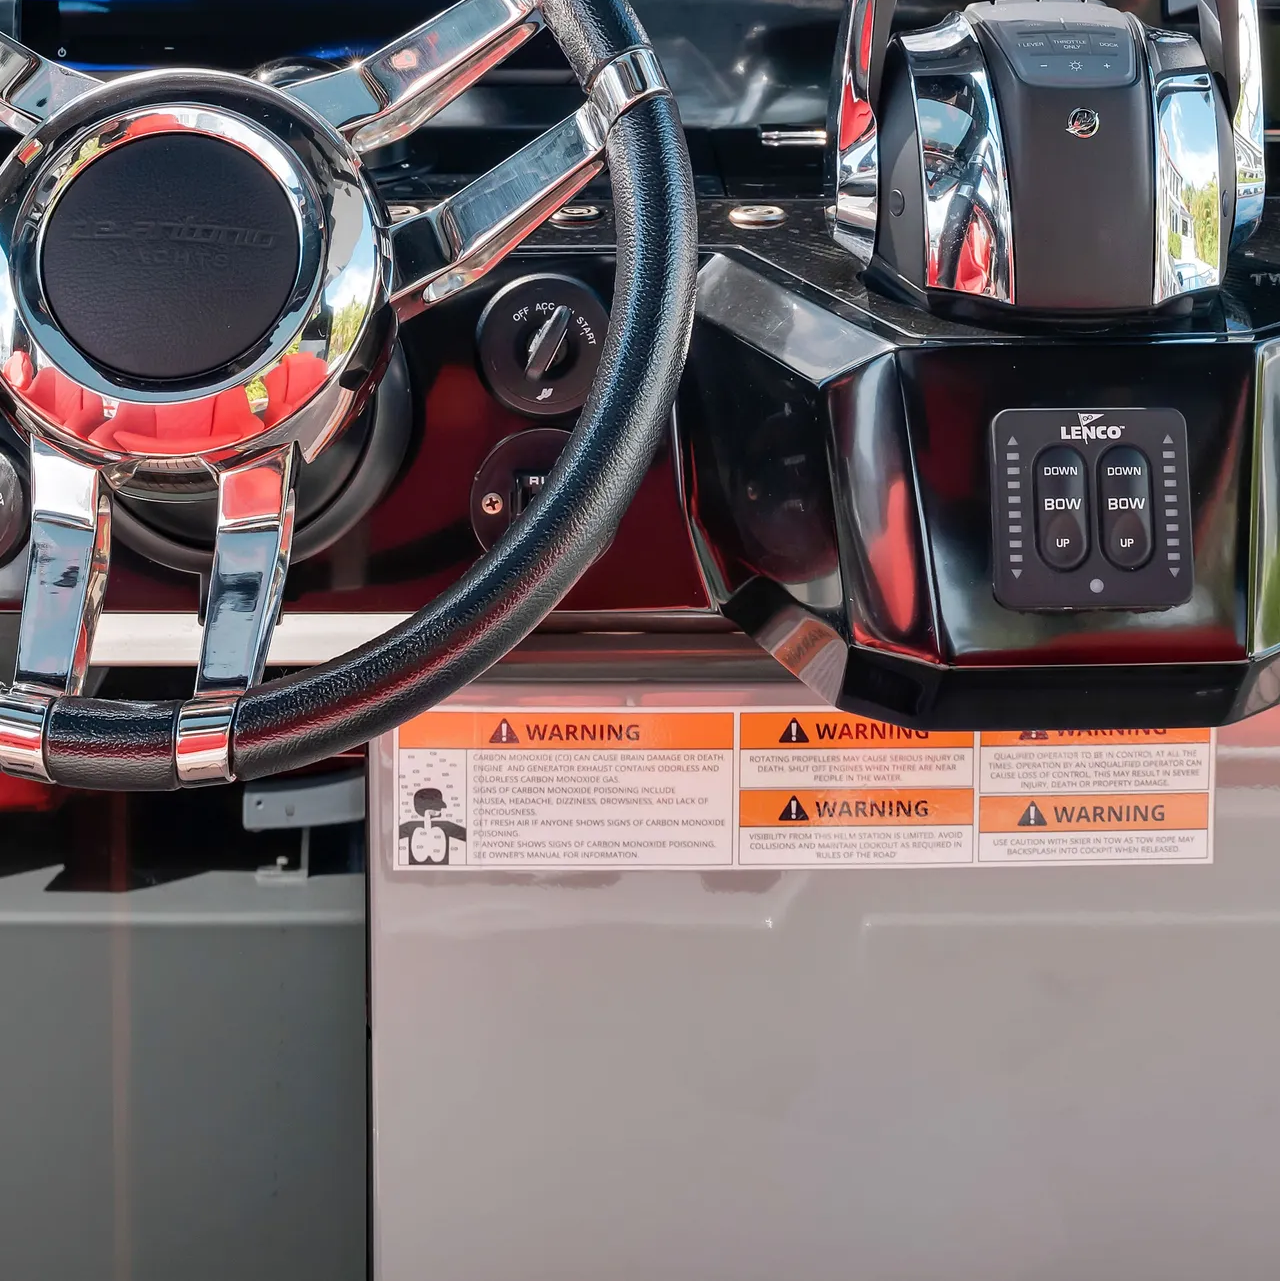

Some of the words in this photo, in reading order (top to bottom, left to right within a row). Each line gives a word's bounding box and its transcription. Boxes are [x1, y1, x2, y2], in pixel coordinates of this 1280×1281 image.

[512, 306, 530, 322] OFF
[535, 302, 556, 312] ACC
[576, 316, 597, 346] START
[1060, 425, 1122, 440] LENCO
[1043, 466, 1078, 476] DOWN
[1107, 466, 1142, 476] DOWN
[1044, 498, 1082, 511] BOW
[1107, 497, 1145, 510] BOW
[1056, 538, 1070, 548] UP
[1120, 538, 1134, 548] UP
[525, 722, 640, 741] WARNING
[815, 800, 929, 818] WARNING
[1053, 805, 1165, 823] WARNING
[1007, 847, 1056, 855] BACKSPLASH
